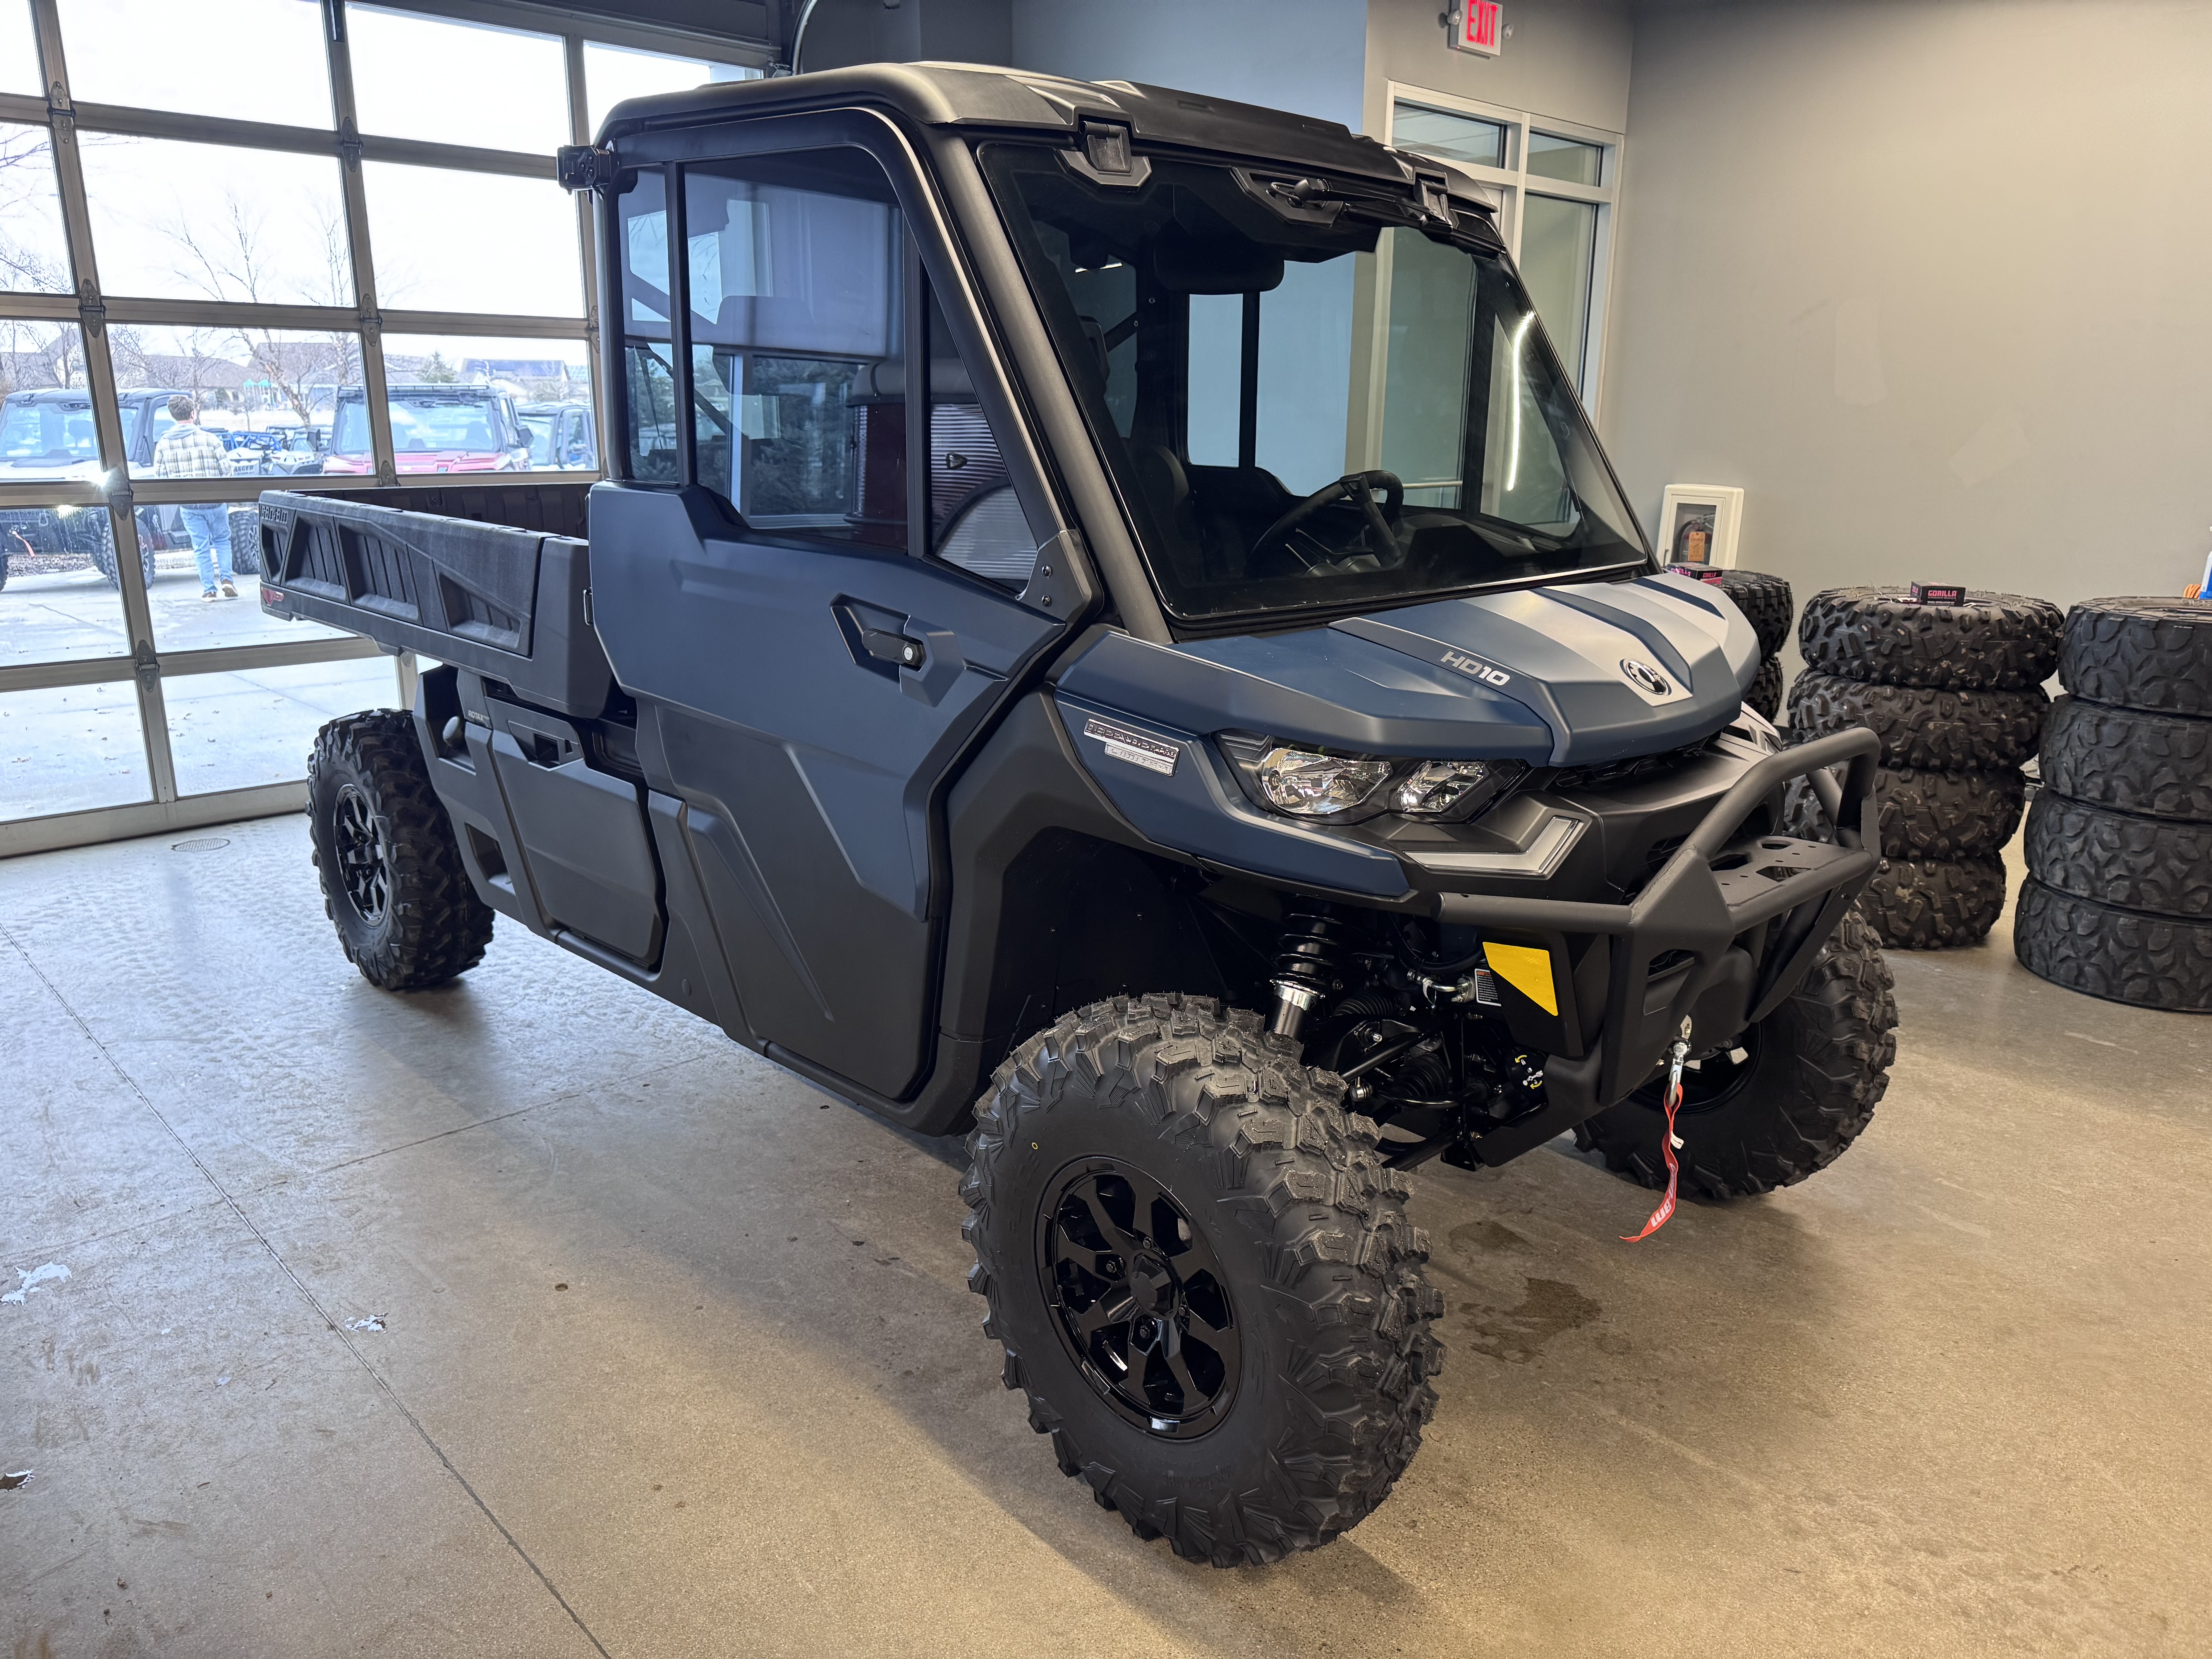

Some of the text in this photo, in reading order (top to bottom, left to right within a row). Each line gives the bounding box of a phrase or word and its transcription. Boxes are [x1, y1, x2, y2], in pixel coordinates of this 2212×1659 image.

[1466, 0, 1498, 48] EXIT
[1441, 651, 1510, 686] HD10
[468, 709, 484, 721] ROTAX
